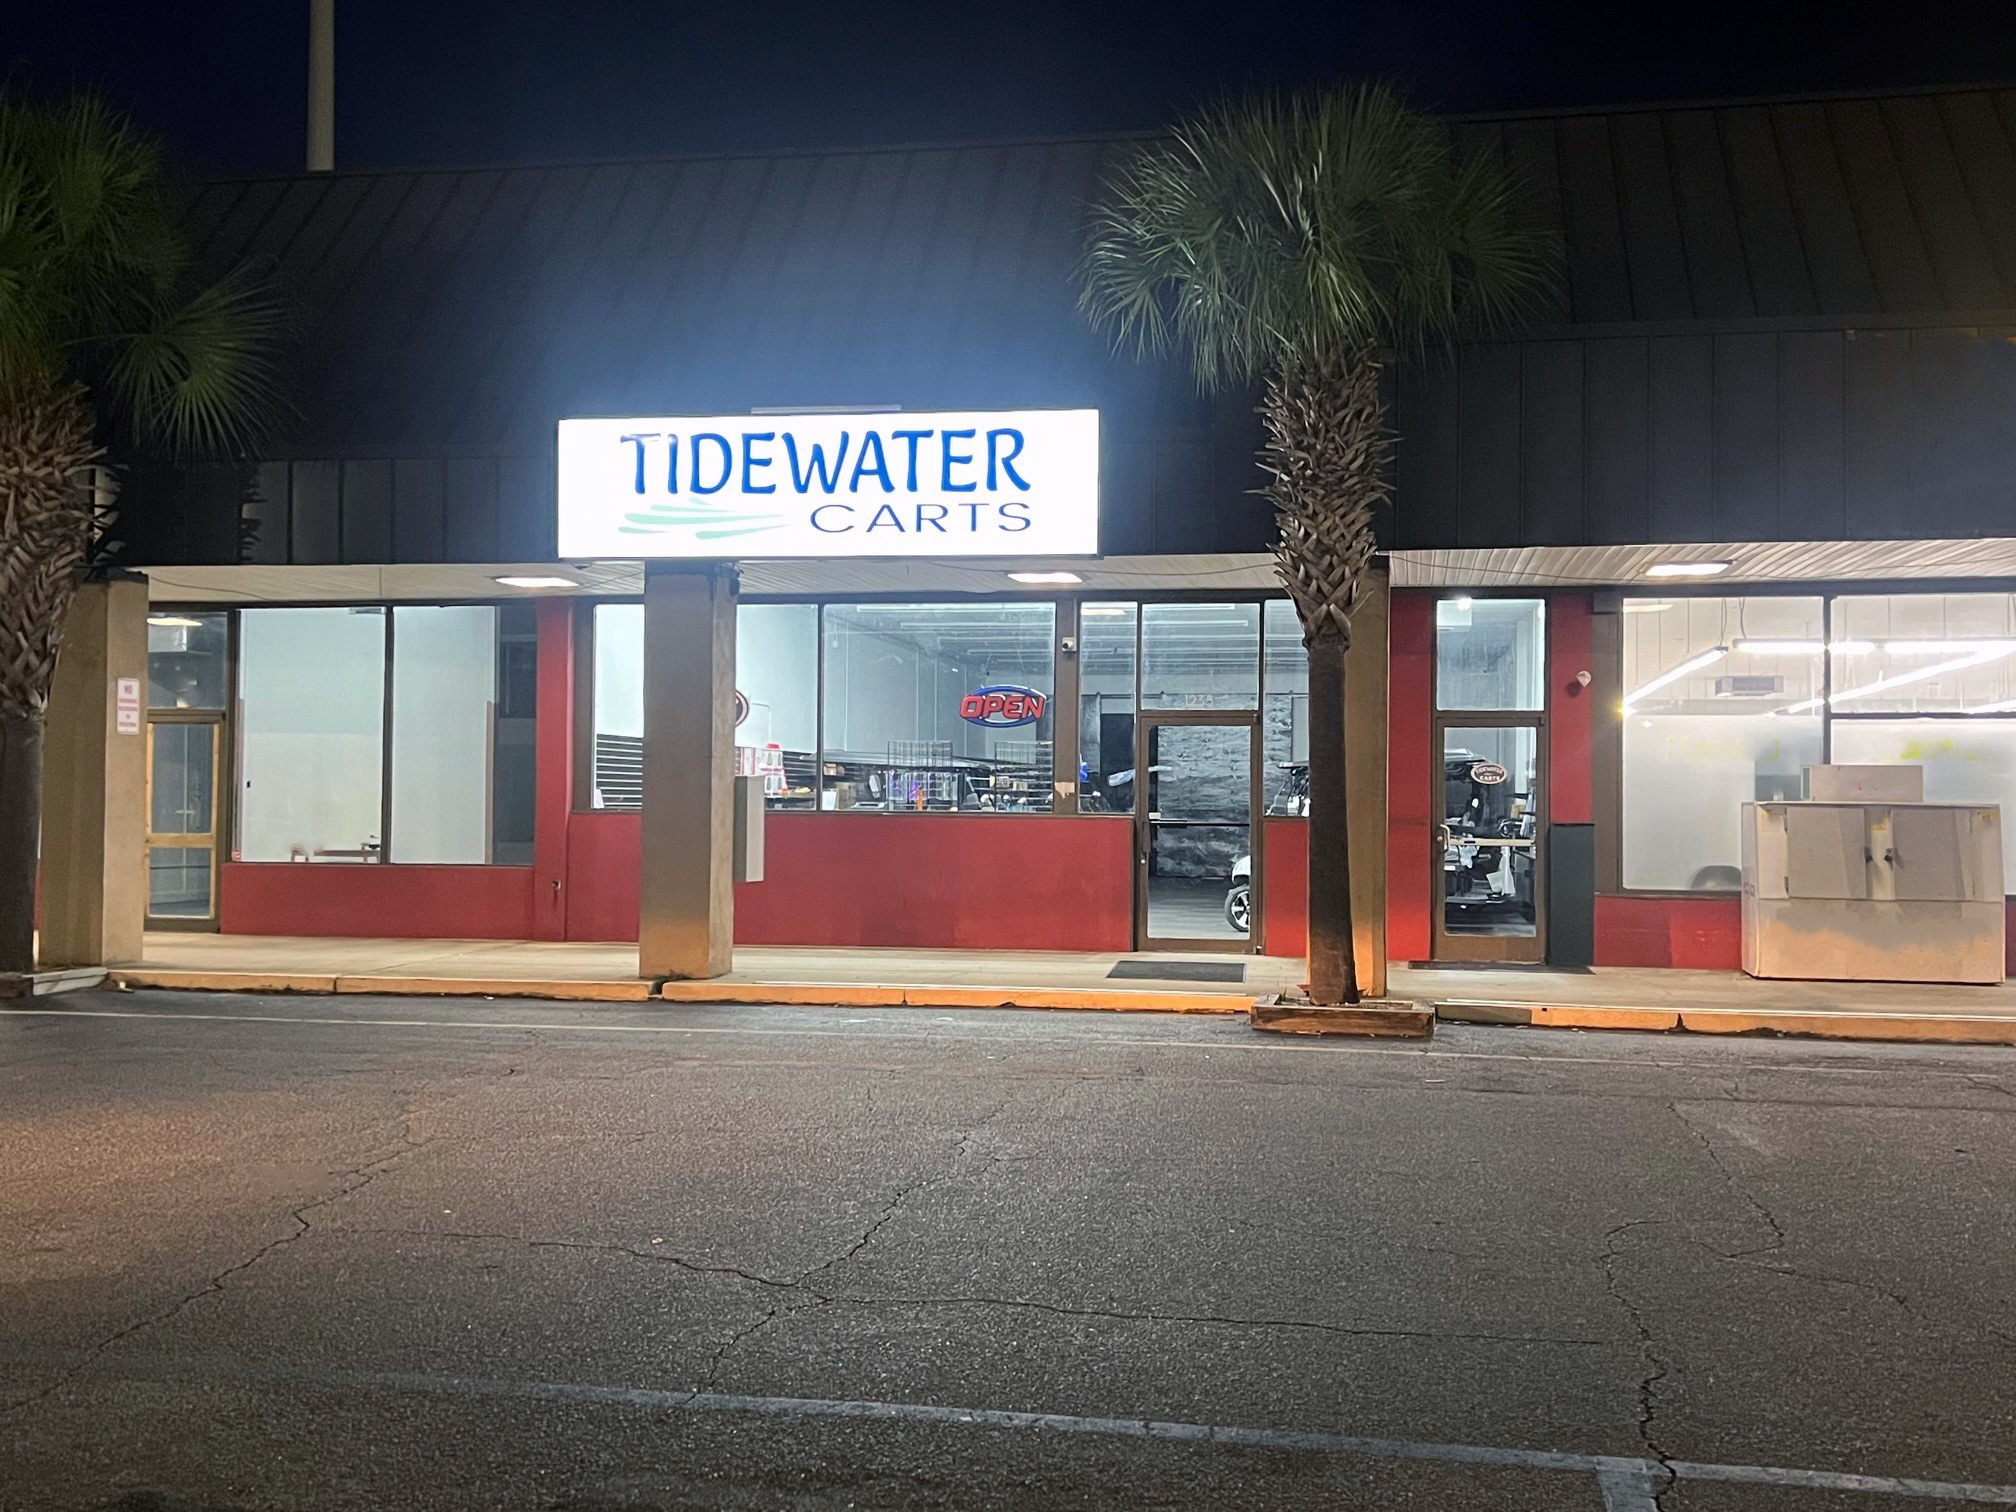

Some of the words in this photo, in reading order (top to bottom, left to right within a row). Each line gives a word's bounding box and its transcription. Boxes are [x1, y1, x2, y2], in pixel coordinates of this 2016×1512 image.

[620, 427, 1031, 495] TIDEWATER
[810, 502, 1032, 533] CARTS
[960, 695, 1046, 719] OPEN
